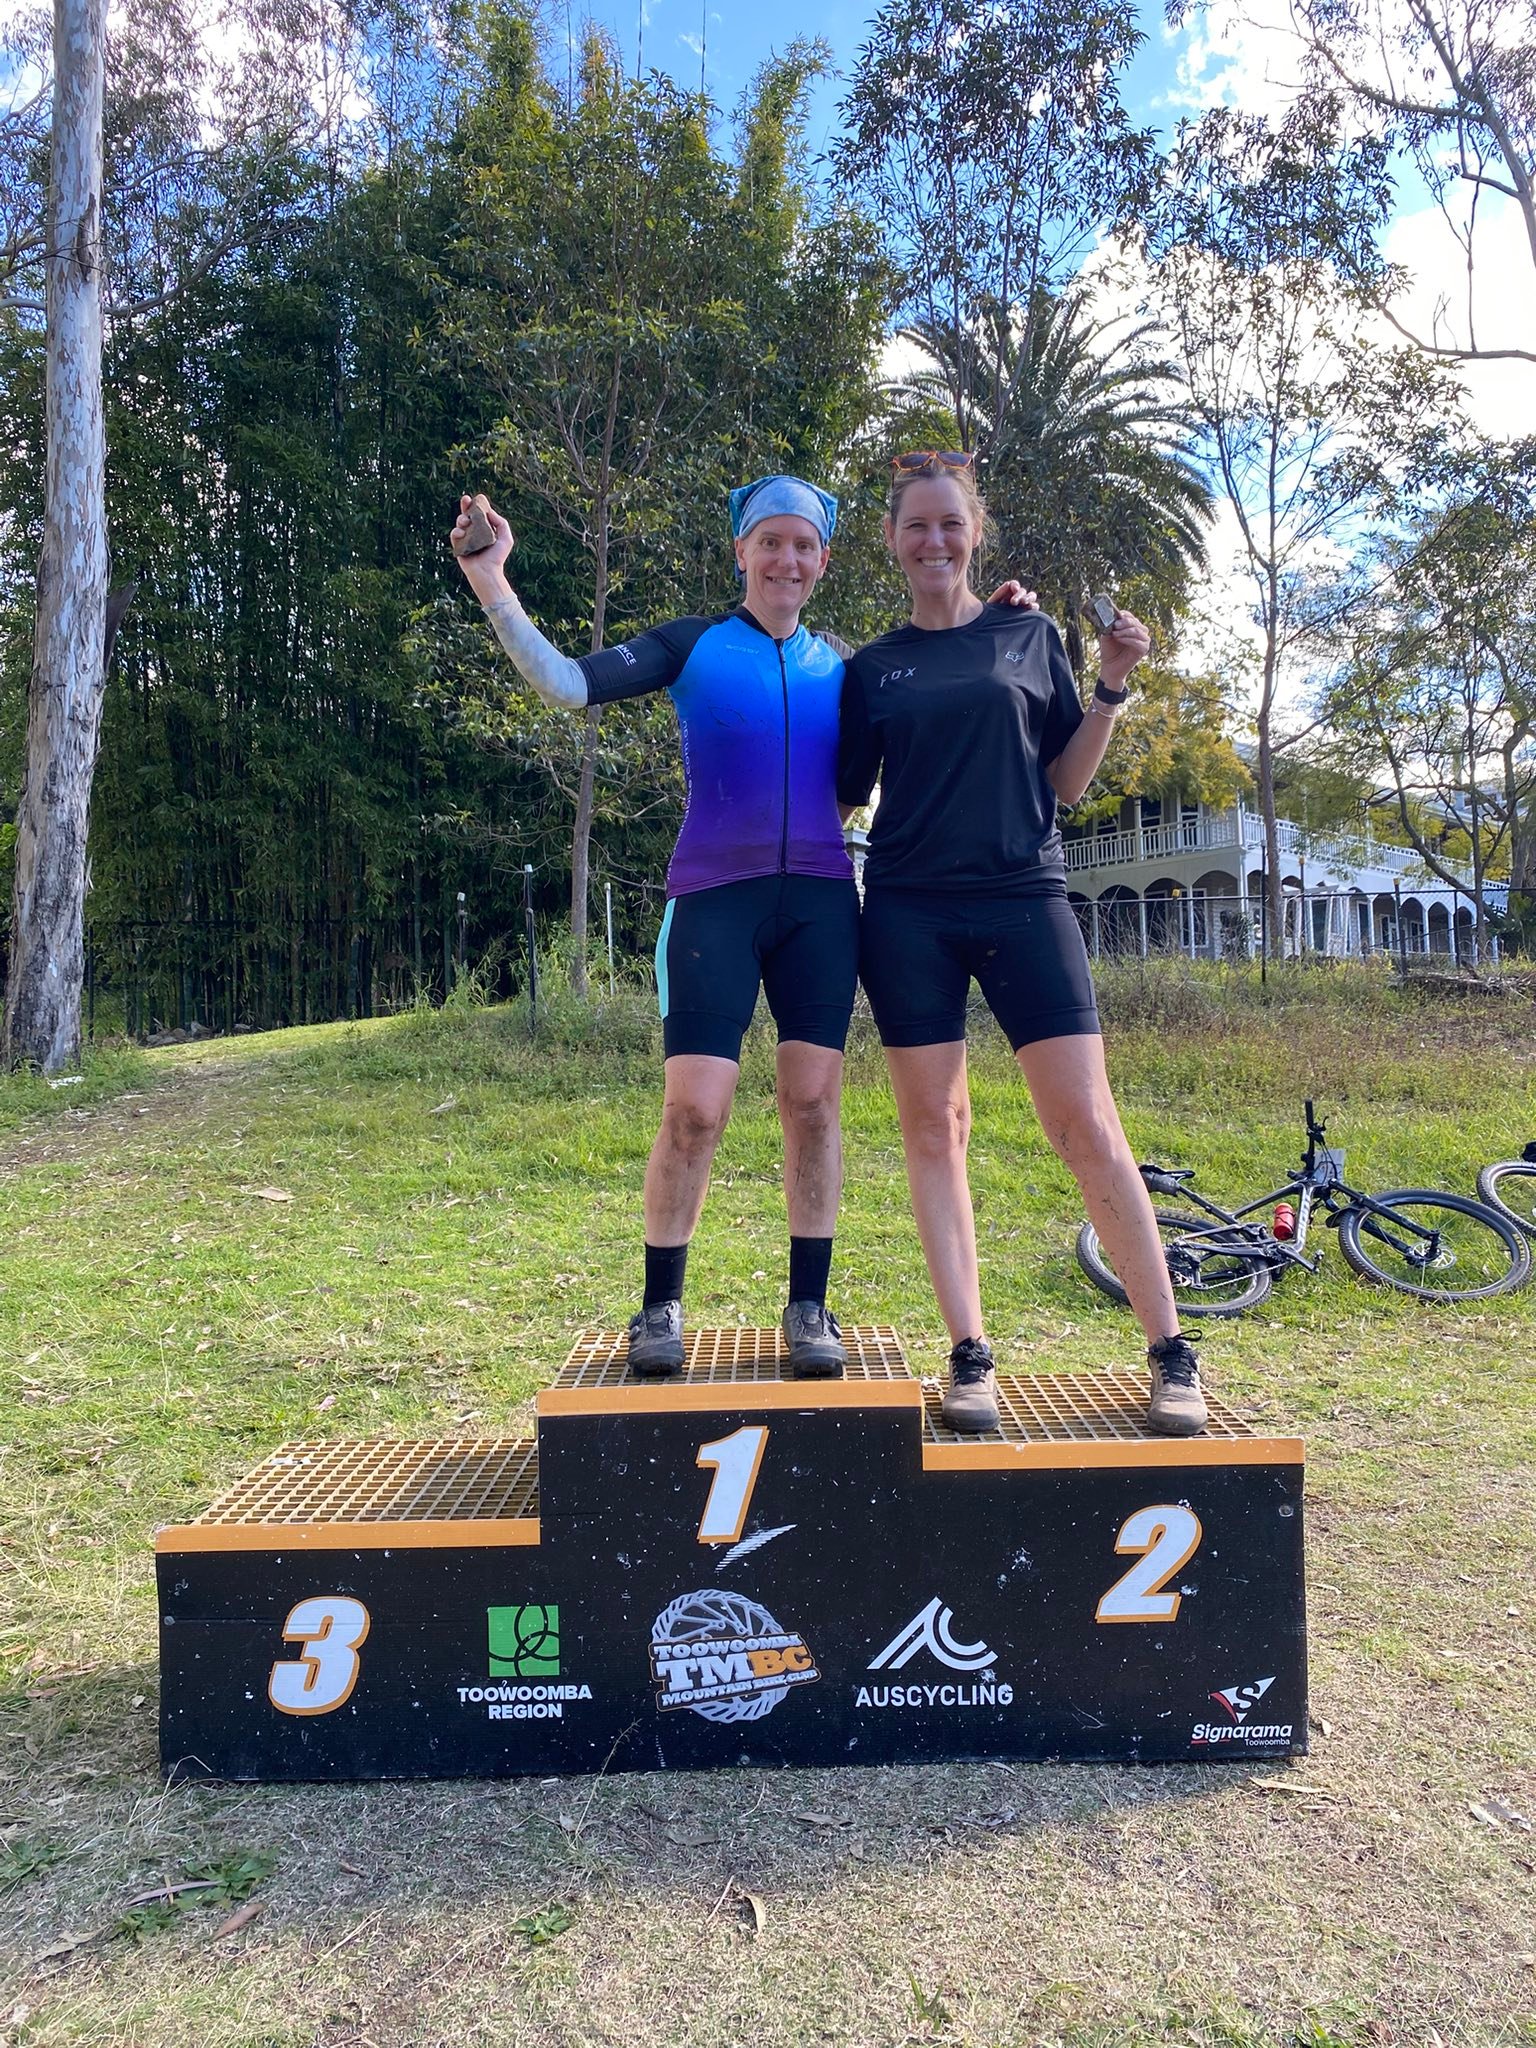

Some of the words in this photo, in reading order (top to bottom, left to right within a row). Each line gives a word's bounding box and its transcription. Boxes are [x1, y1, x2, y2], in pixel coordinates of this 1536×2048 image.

[880, 667, 917, 688] FOX
[696, 1426, 770, 1543] 1
[1095, 1504, 1203, 1624] 2
[268, 1595, 371, 1717] 3
[653, 1634, 803, 1660] TOOWOOMBA
[656, 1646, 812, 1692] TMBC
[457, 1685, 593, 1702] TOOWOOMBA
[661, 1681, 752, 1706] MOUNTAIN
[785, 1670, 818, 1684] CLUB
[855, 1685, 1014, 1707] AUSCYCLING
[488, 1703, 562, 1719] REGION
[1191, 1723, 1293, 1743] Signarama
[1244, 1738, 1291, 1747] Toowoomba
